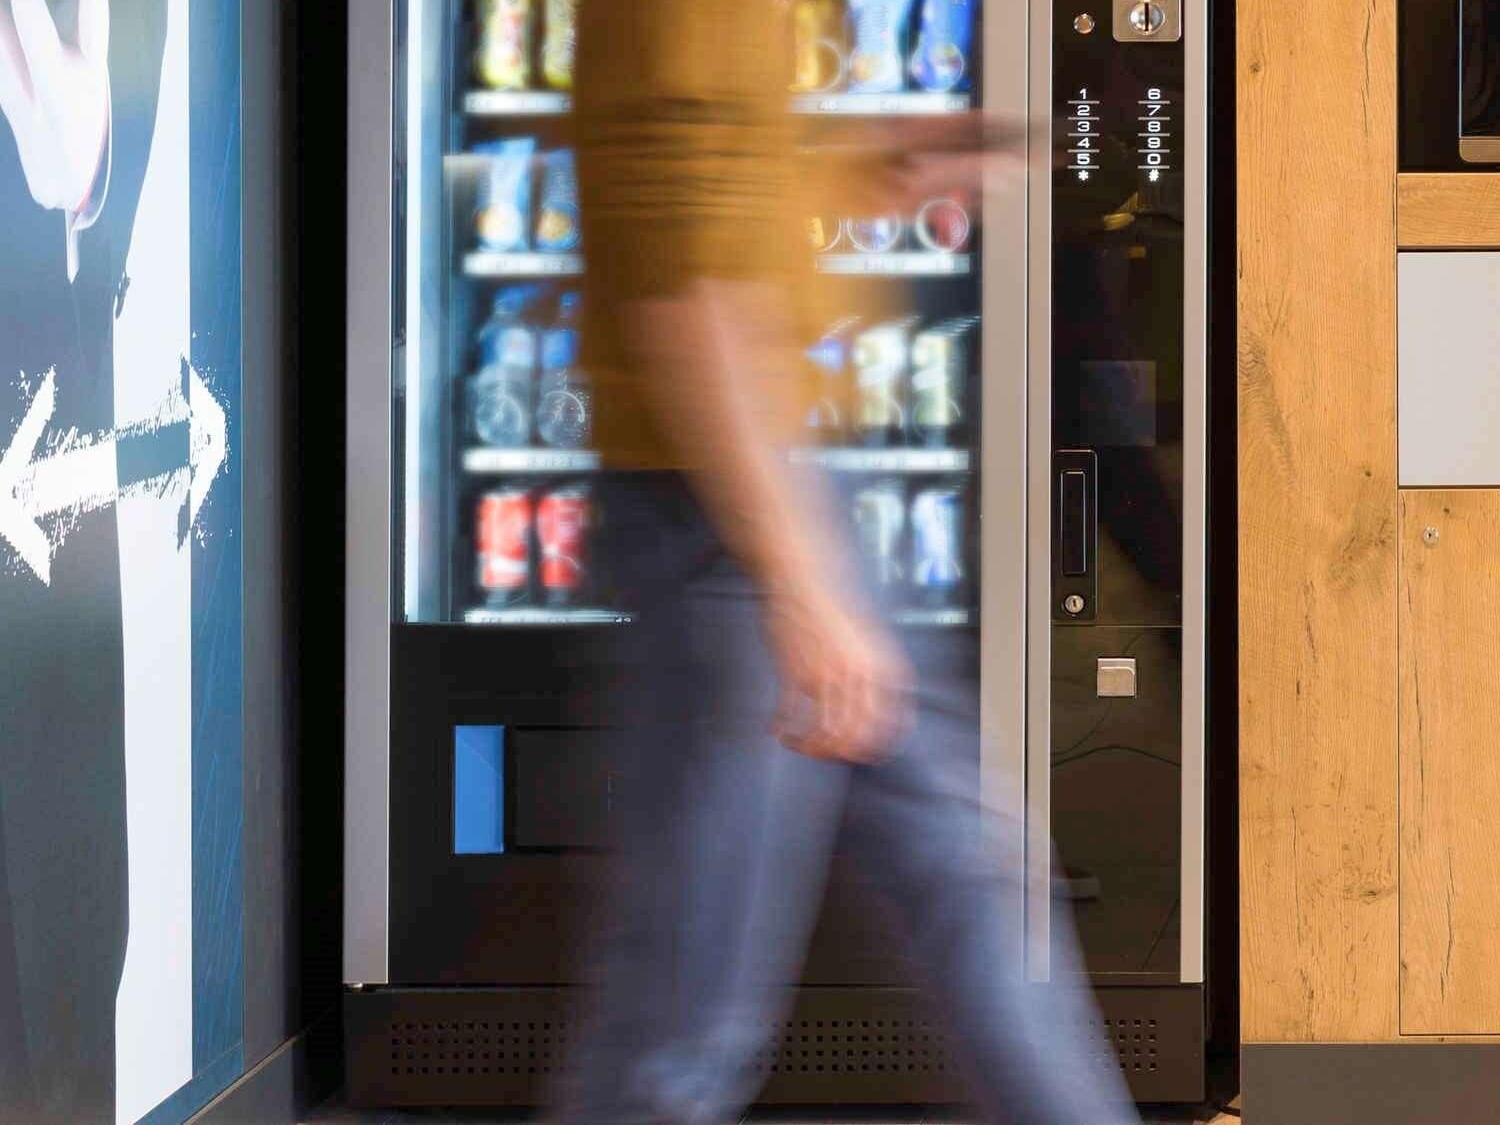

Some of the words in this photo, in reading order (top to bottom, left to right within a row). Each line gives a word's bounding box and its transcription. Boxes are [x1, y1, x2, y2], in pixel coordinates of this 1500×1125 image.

[1080, 88, 1087, 100] 1
[1148, 88, 1161, 100] 6
[1077, 105, 1090, 116] 2
[1147, 105, 1161, 116] 7
[1077, 121, 1090, 132] 3
[1147, 121, 1161, 132] 8
[1077, 137, 1090, 148] 4
[1147, 137, 1161, 148] 9
[1077, 153, 1090, 165] 5
[1147, 153, 1161, 165] 0
